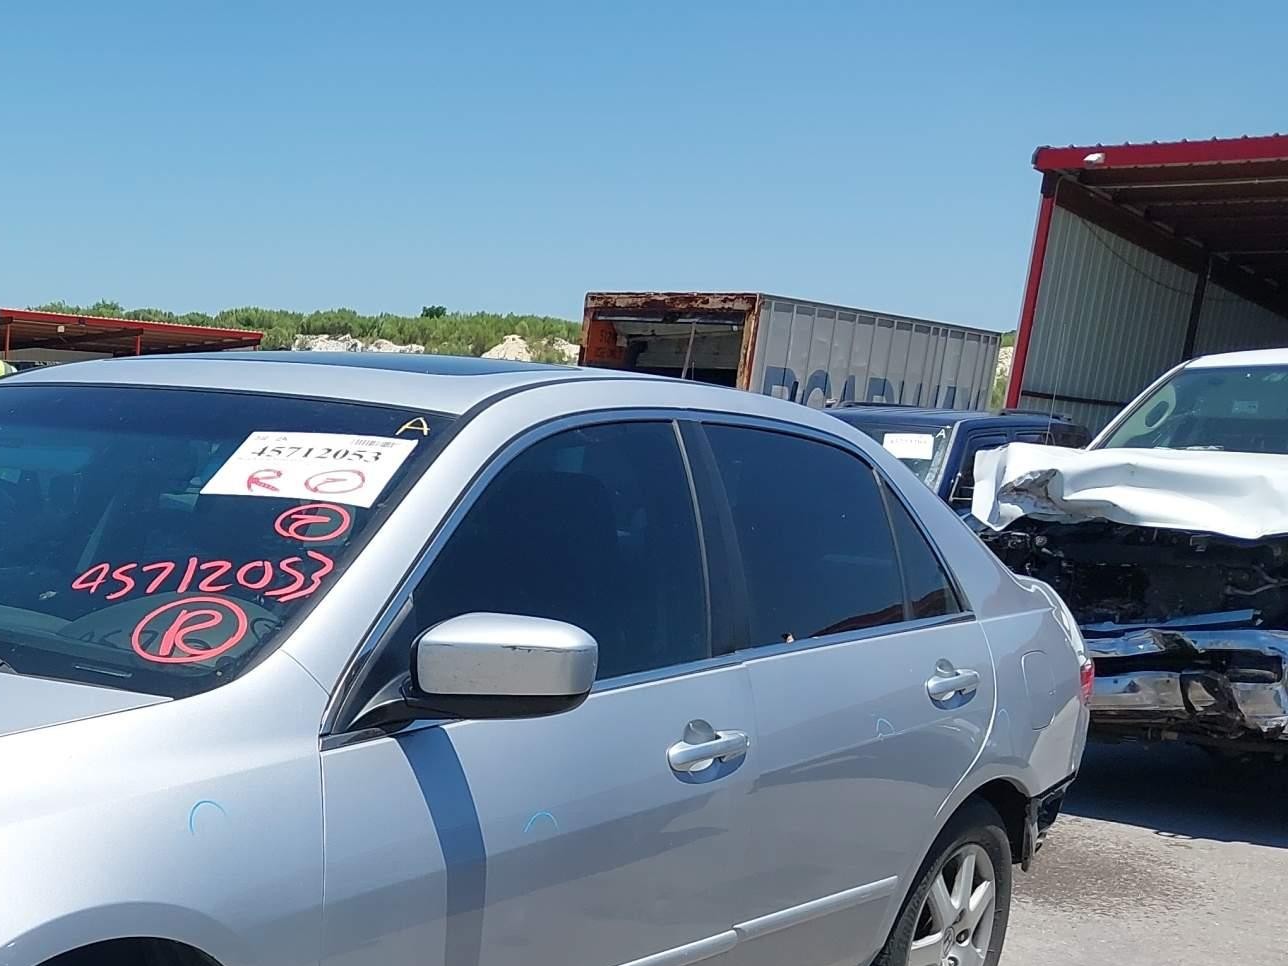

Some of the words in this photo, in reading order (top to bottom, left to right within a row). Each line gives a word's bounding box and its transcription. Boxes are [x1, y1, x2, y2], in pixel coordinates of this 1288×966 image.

[395, 416, 430, 437] A
[935, 428, 946, 439] A
[251, 445, 383, 463] 45712053
[71, 550, 335, 602] 45712053
